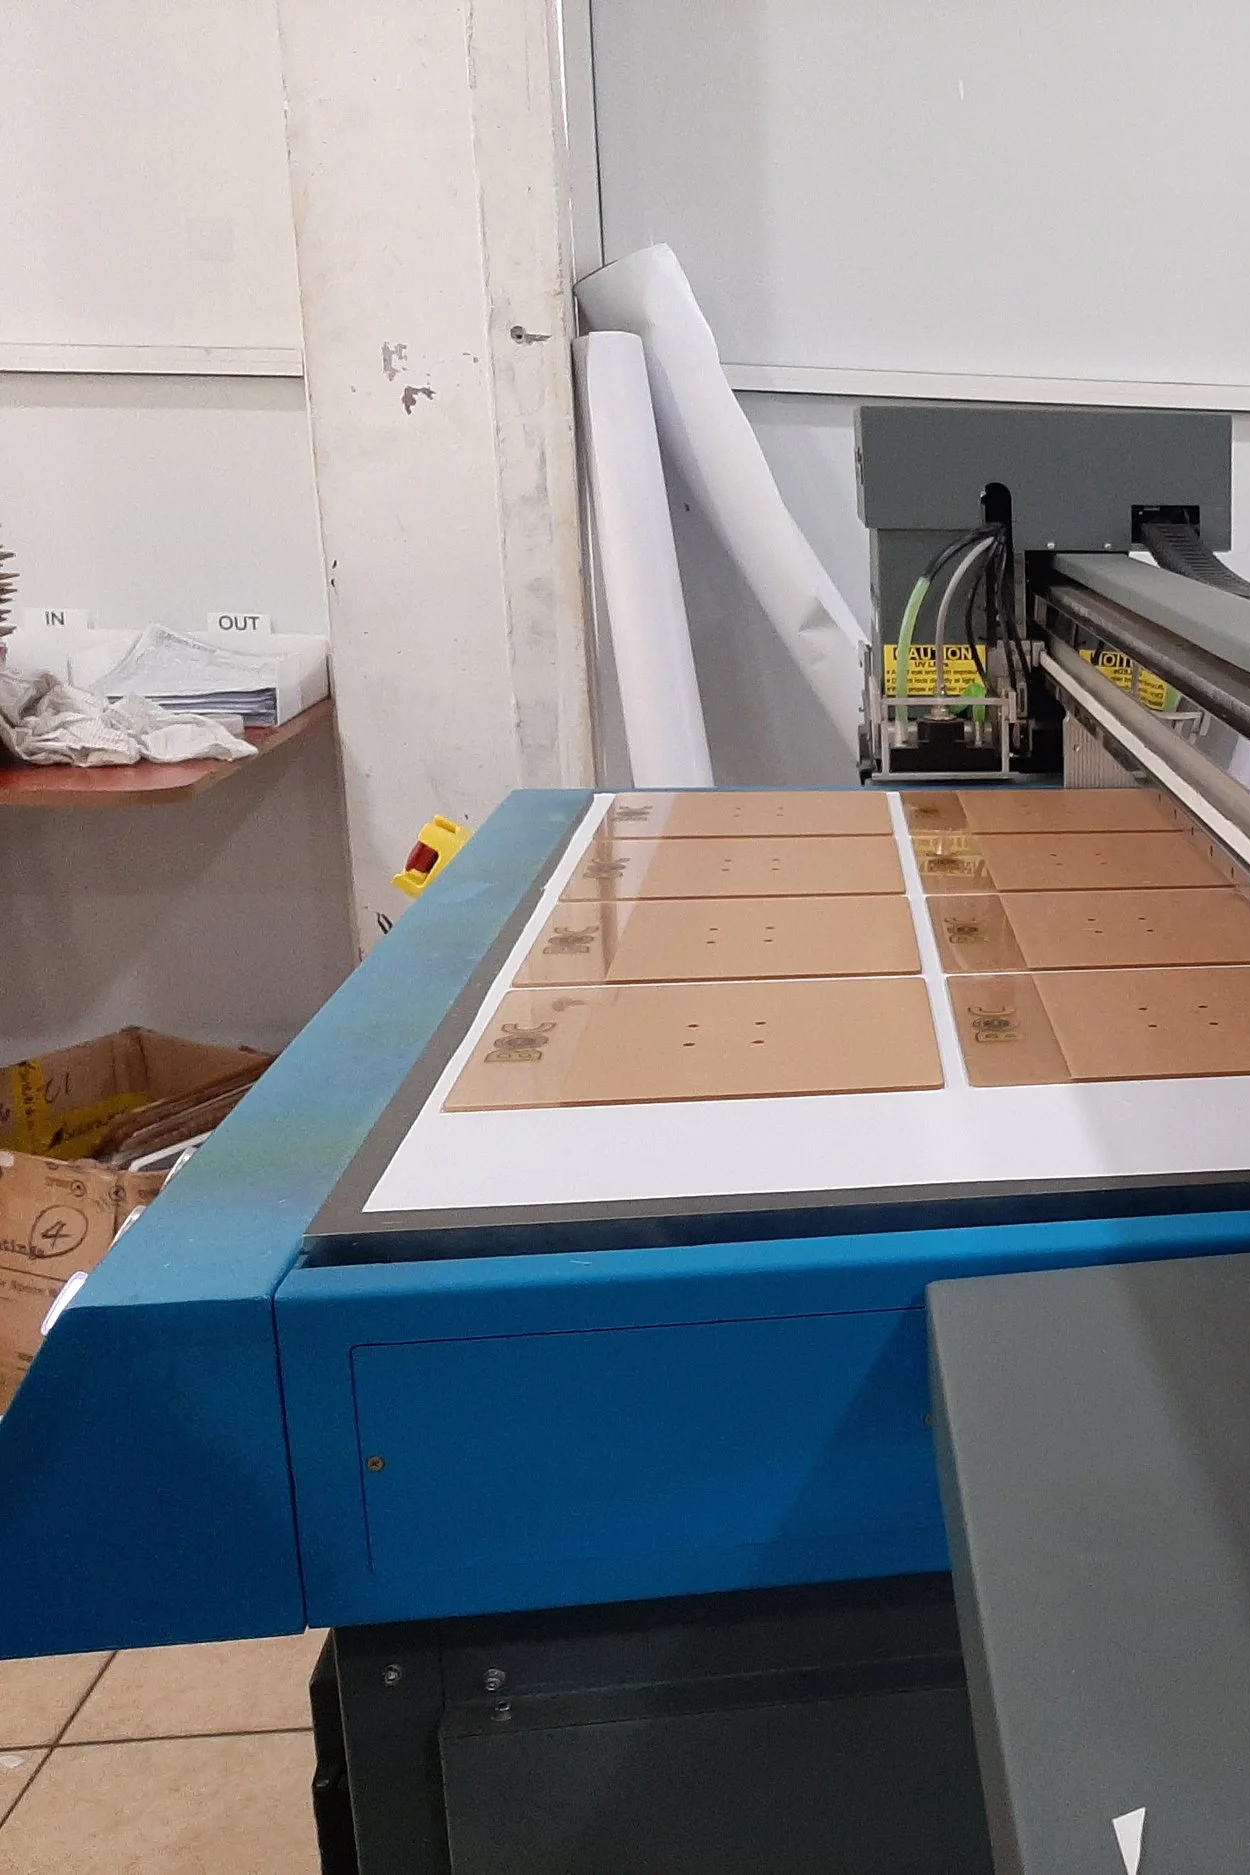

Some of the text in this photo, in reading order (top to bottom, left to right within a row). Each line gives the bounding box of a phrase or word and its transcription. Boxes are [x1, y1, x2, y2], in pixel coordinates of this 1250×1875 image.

[45, 611, 65, 626] IN
[218, 615, 260, 632] OUT
[895, 647, 972, 660] AUION
[41, 1220, 71, 1250] 4
